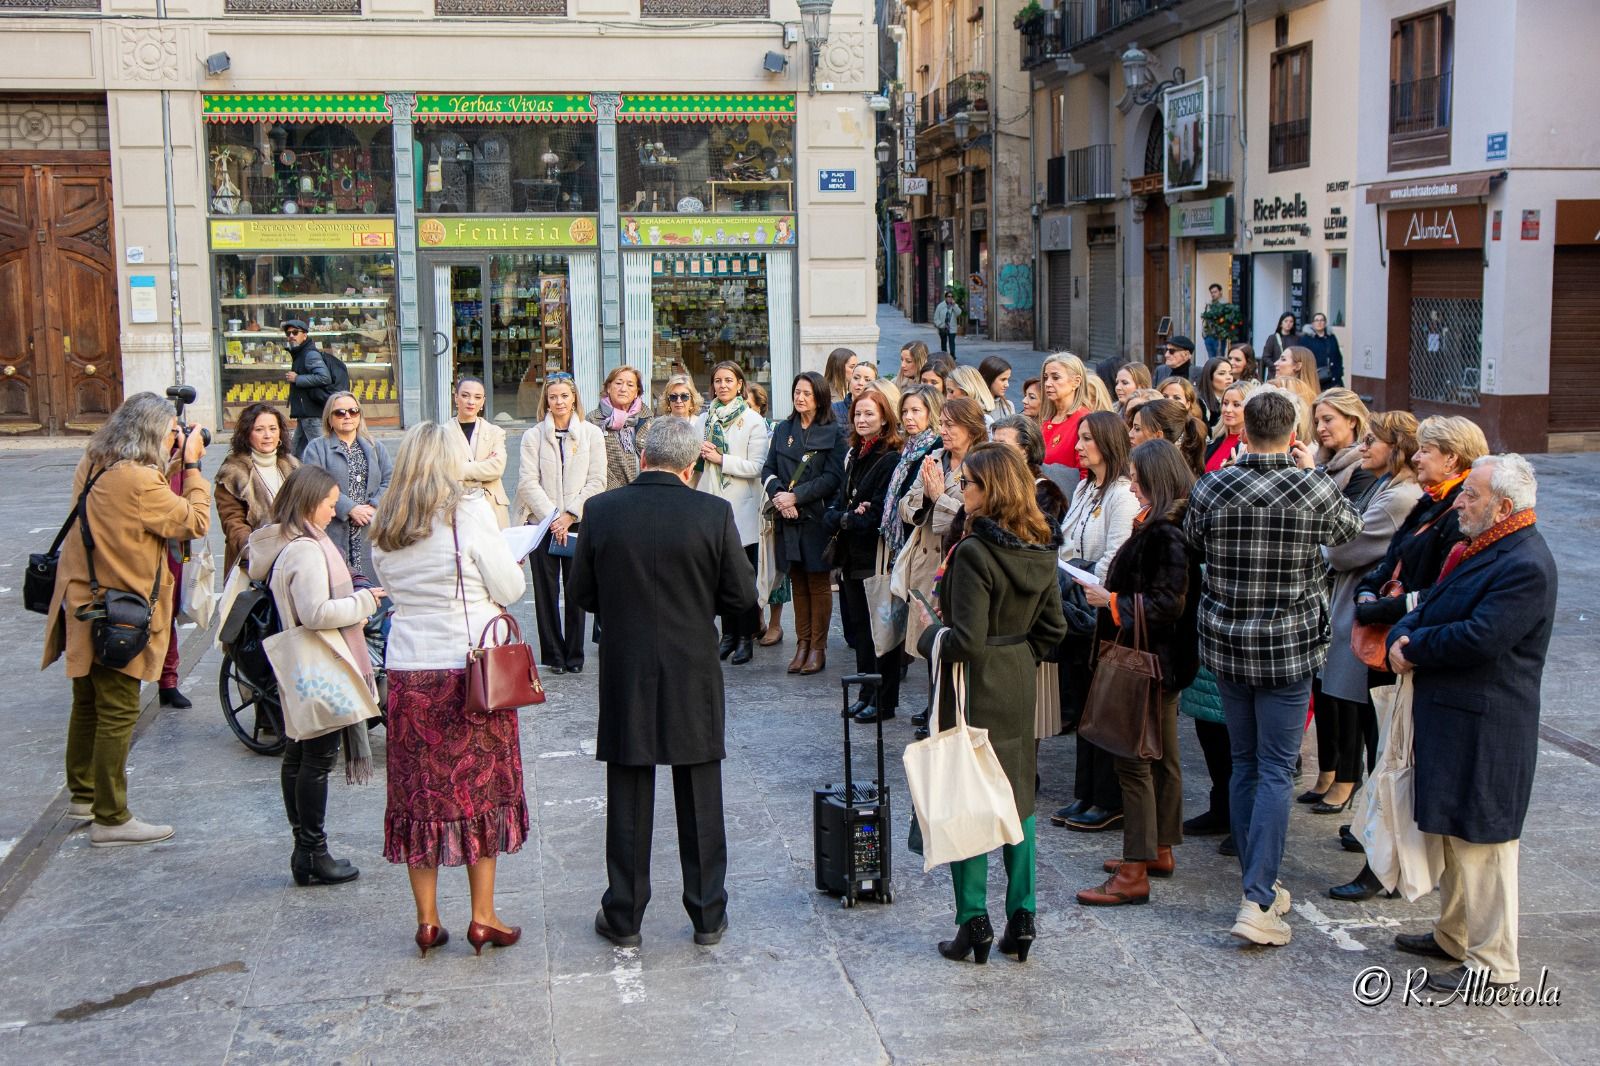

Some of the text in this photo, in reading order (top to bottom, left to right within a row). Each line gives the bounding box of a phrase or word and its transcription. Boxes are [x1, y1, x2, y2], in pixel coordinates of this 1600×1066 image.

[449, 95, 554, 113] Yerbas Vivas
[904, 93, 915, 172] JOYERIA
[1326, 181, 1349, 193] DELIVERY
[1254, 192, 1307, 222] RicePaella
[455, 223, 560, 241] Fenitzia
[1324, 216, 1348, 230] LLEVAR
